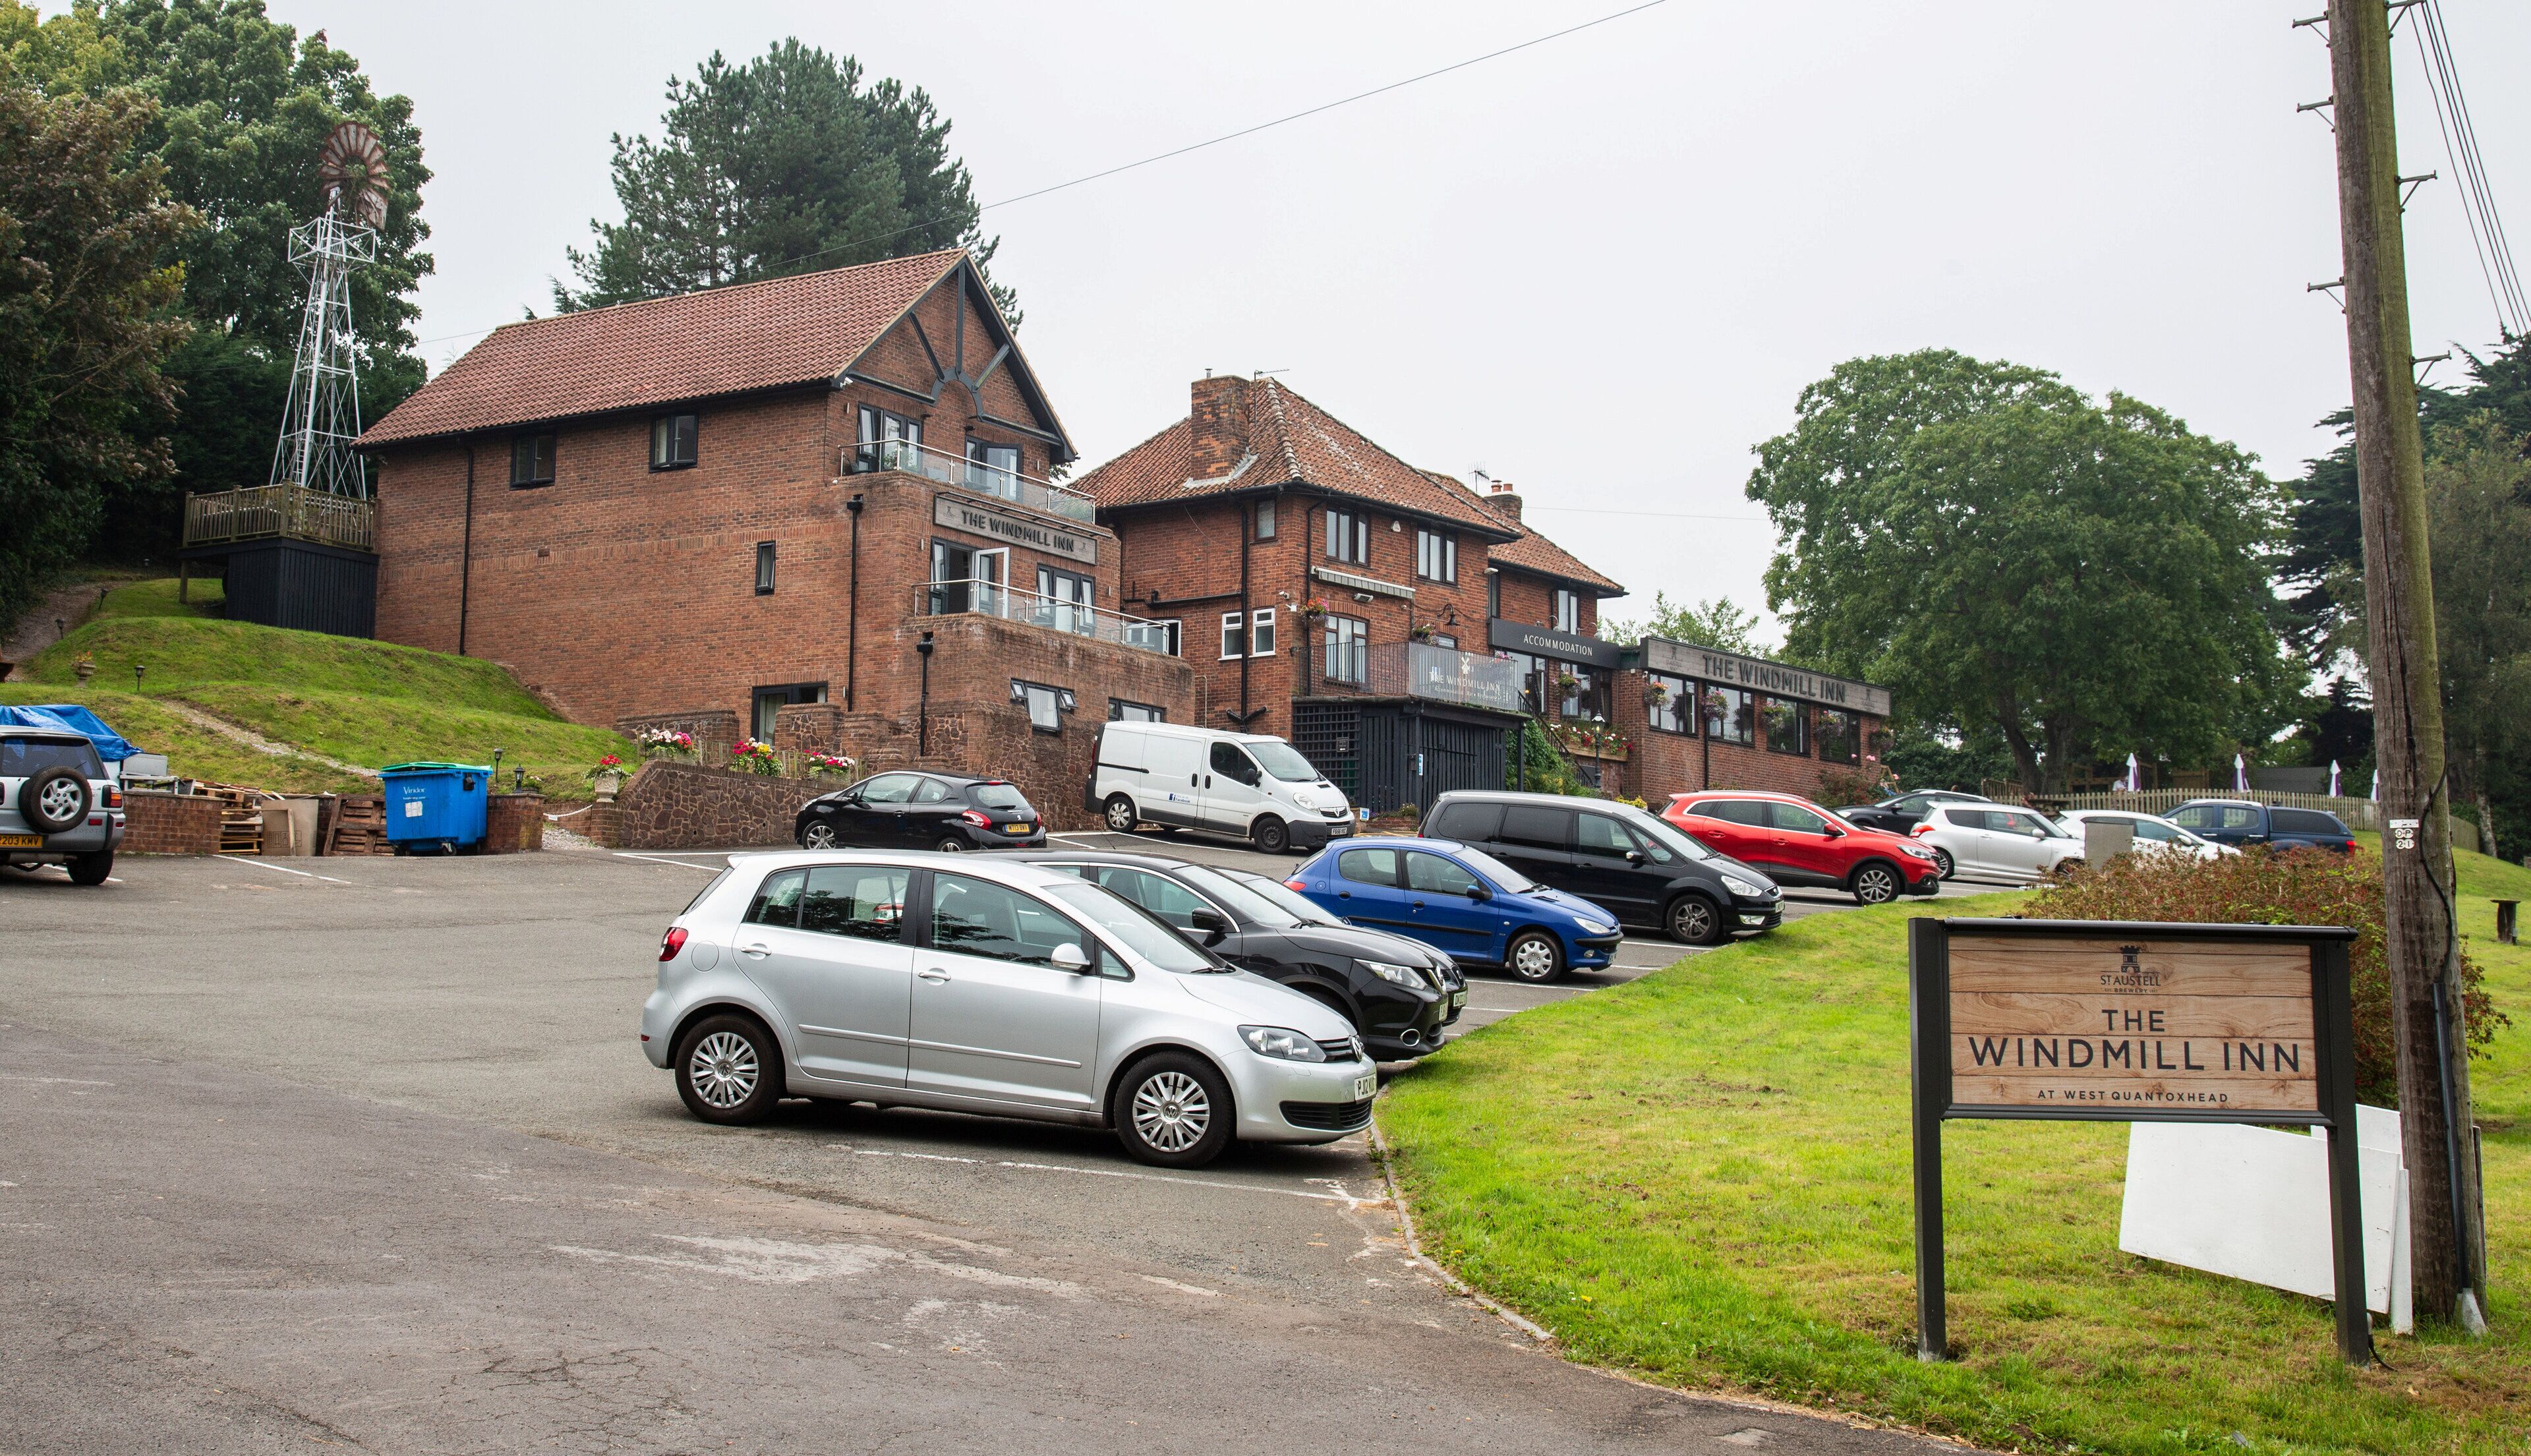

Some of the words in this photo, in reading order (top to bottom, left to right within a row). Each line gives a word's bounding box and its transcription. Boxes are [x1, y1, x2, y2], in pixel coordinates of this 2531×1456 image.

[962, 510, 986, 529] THE
[989, 517, 1051, 546] WINDMILL
[1053, 535, 1074, 552] INN
[1523, 634, 1592, 656] ACCOMMODATION
[1446, 675, 1486, 690] WINDMILL
[1702, 654, 1733, 680] THE
[1738, 661, 1817, 697] WINDMILL
[1820, 680, 1846, 703] INN
[22, 836, 39, 845] KMV
[2113, 976, 2161, 987] AUSTELL
[2102, 1009, 2165, 1032] THE
[1967, 1036, 2205, 1071] WINDMILL
[2223, 1041, 2300, 1072] INN
[2037, 1090, 2055, 1099] AT
[2064, 1090, 2106, 1101] WEST
[2111, 1091, 2228, 1103] QUANTOXHEAD
